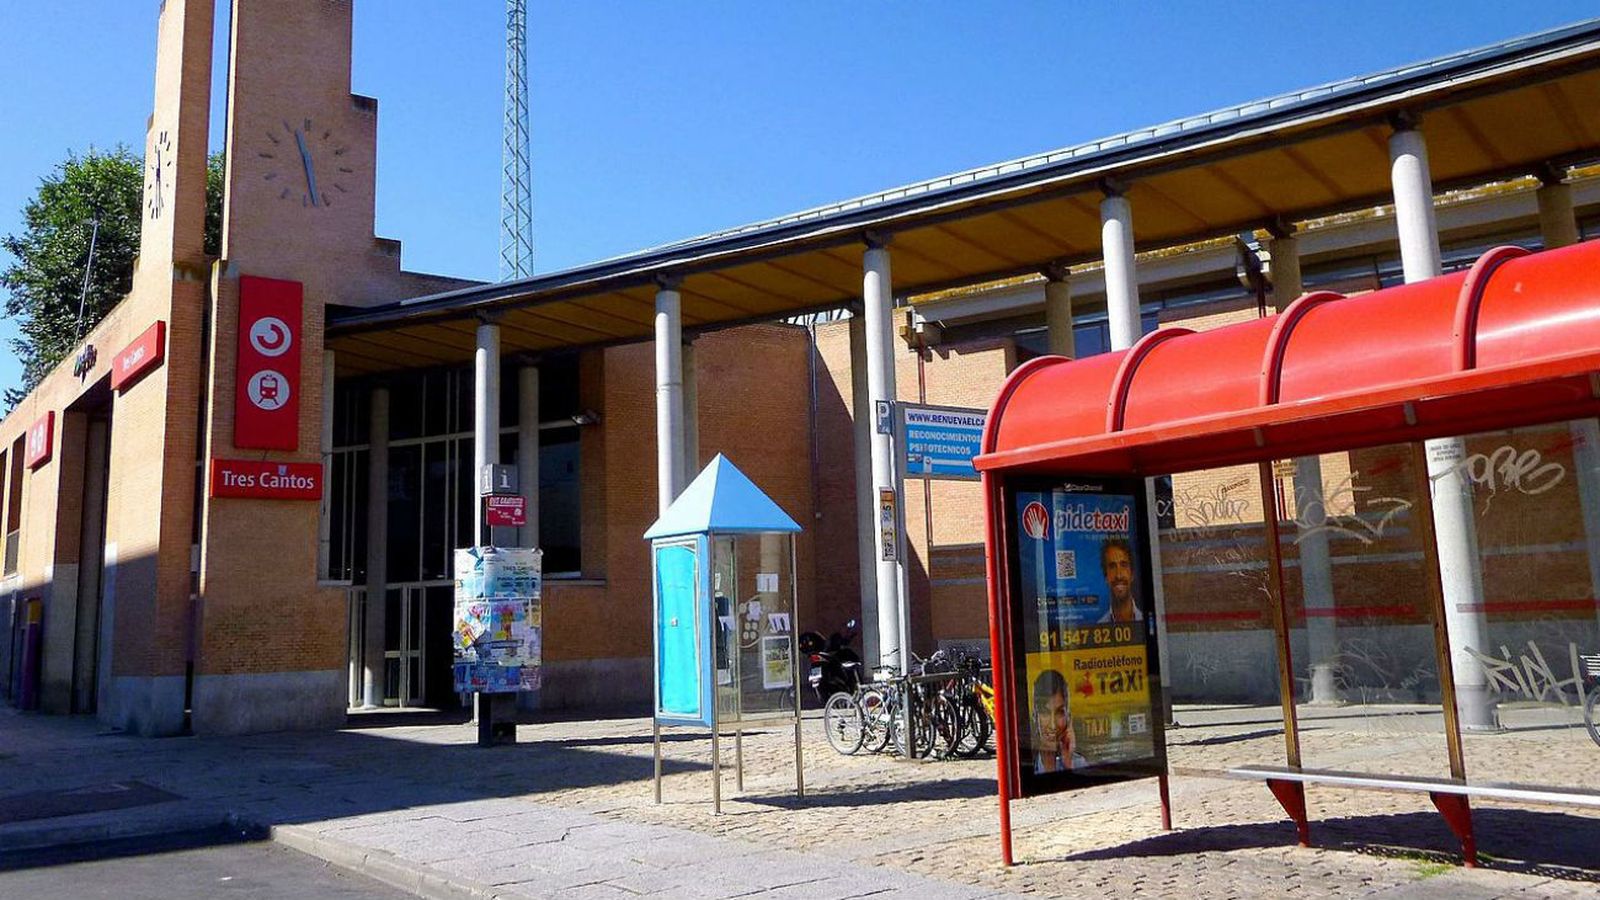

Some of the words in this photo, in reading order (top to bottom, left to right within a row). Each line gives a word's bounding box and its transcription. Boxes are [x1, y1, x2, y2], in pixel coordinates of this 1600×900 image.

[221, 470, 255, 487] Tres
[259, 472, 315, 490] Cantos
[1053, 504, 1130, 539] pidetaxi
[1040, 631, 1057, 647] 91
[1063, 629, 1089, 645] 547
[1094, 628, 1111, 644] 82
[1115, 626, 1131, 642] 00
